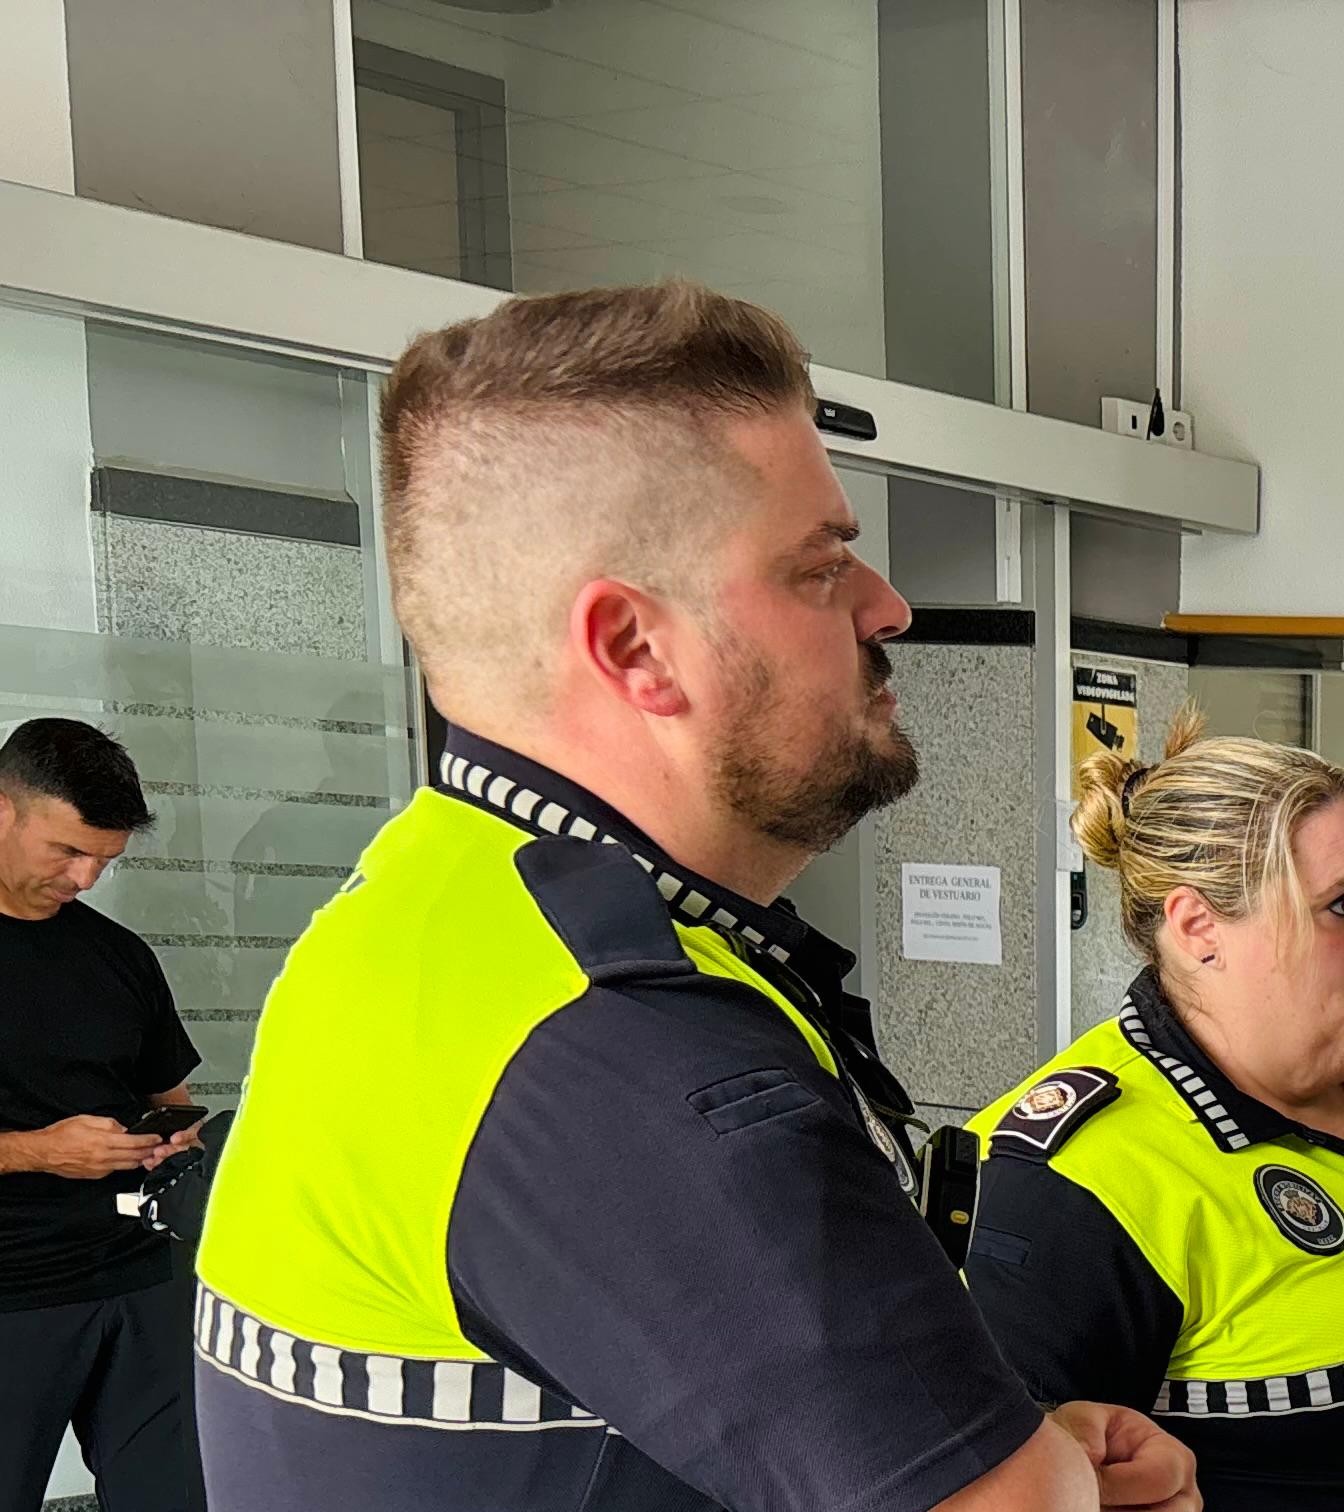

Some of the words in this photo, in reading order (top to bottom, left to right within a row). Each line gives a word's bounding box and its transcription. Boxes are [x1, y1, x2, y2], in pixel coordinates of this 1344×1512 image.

[908, 875, 948, 886] ENTREGA
[951, 876, 991, 889] GENERAL
[919, 888, 929, 899] DE
[931, 889, 981, 900] VESTUARIO
